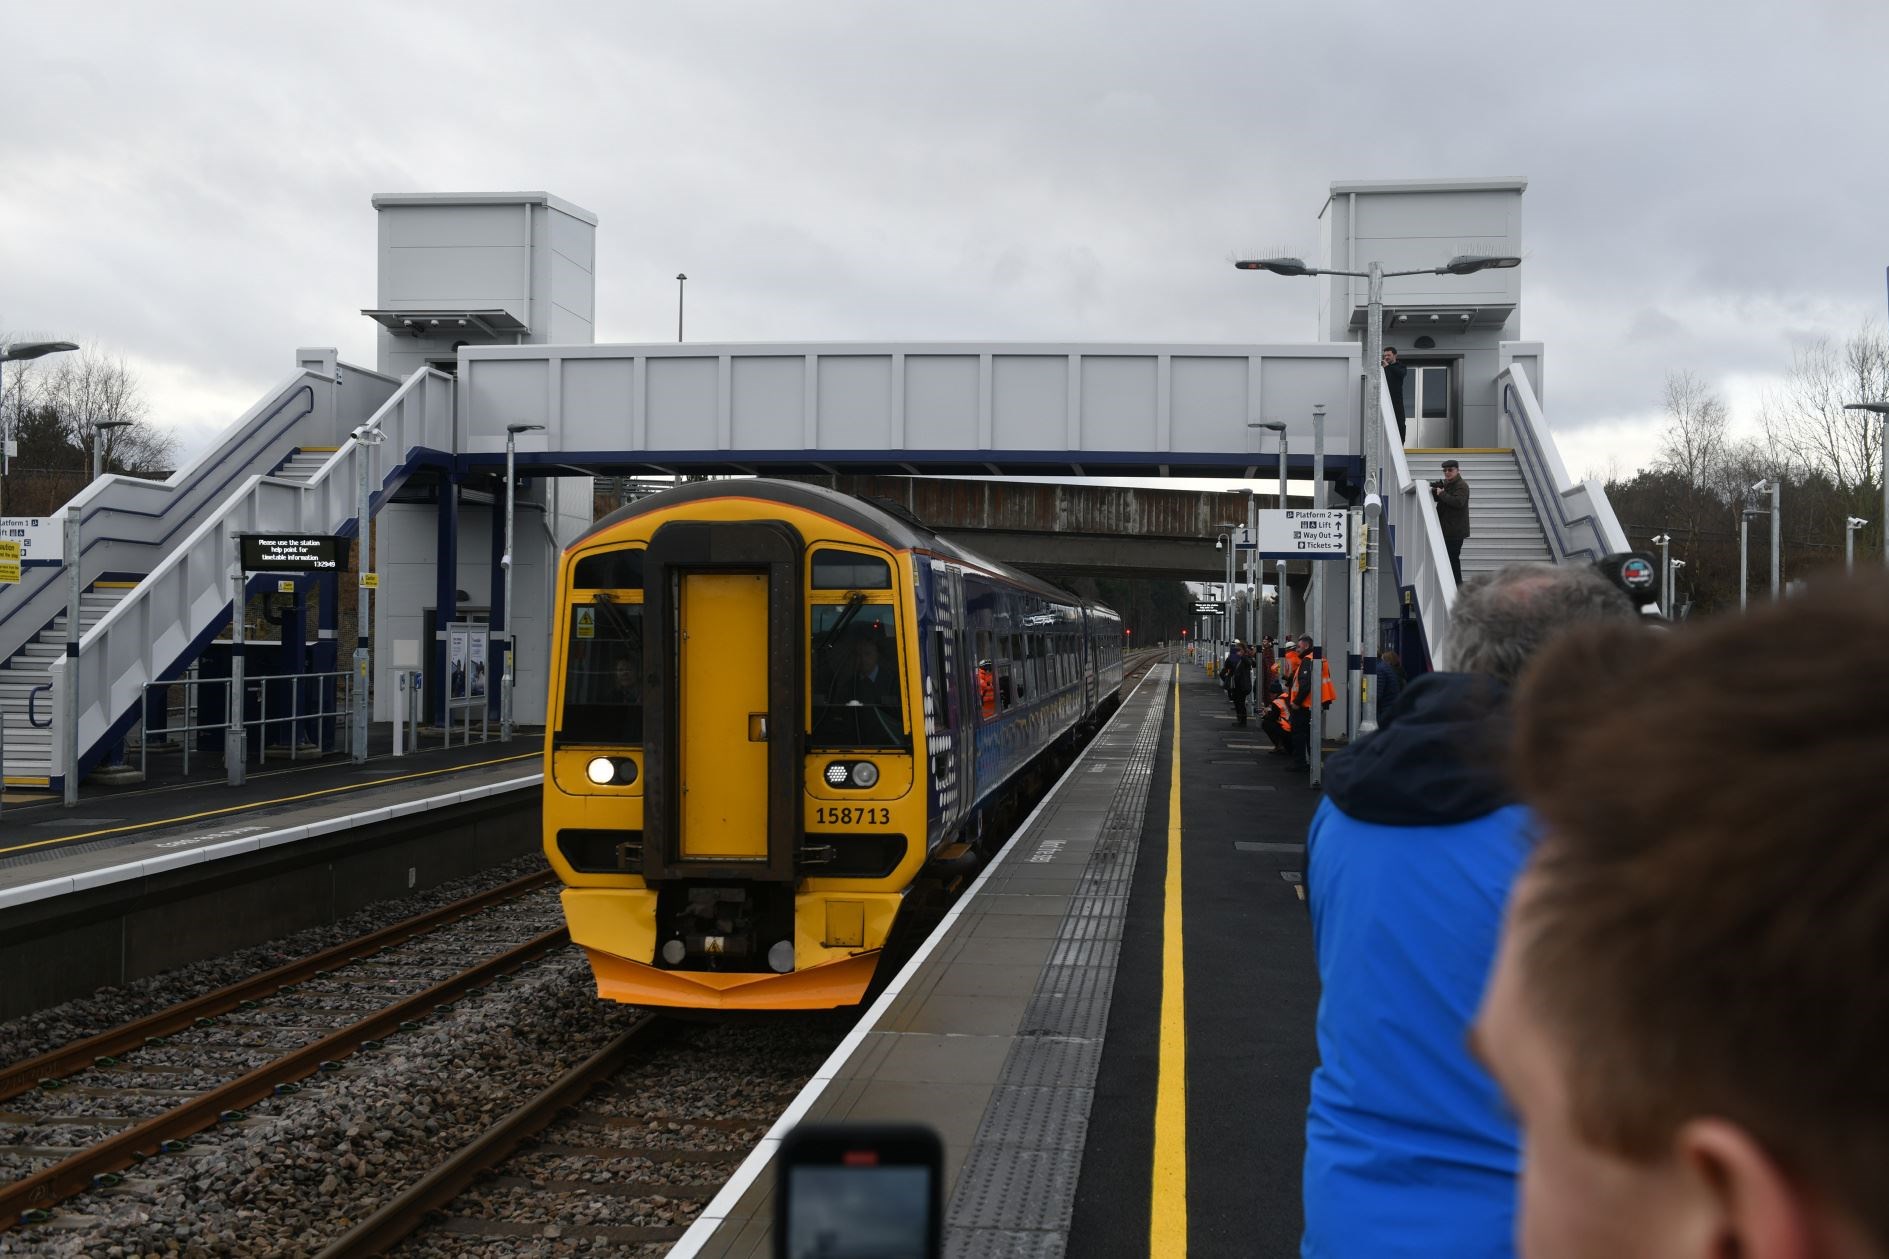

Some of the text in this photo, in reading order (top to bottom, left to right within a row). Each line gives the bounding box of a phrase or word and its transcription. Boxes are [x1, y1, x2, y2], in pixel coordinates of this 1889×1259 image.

[1242, 530, 1250, 543] 1
[1304, 532, 1317, 540] Way
[816, 808, 890, 824] 158713
